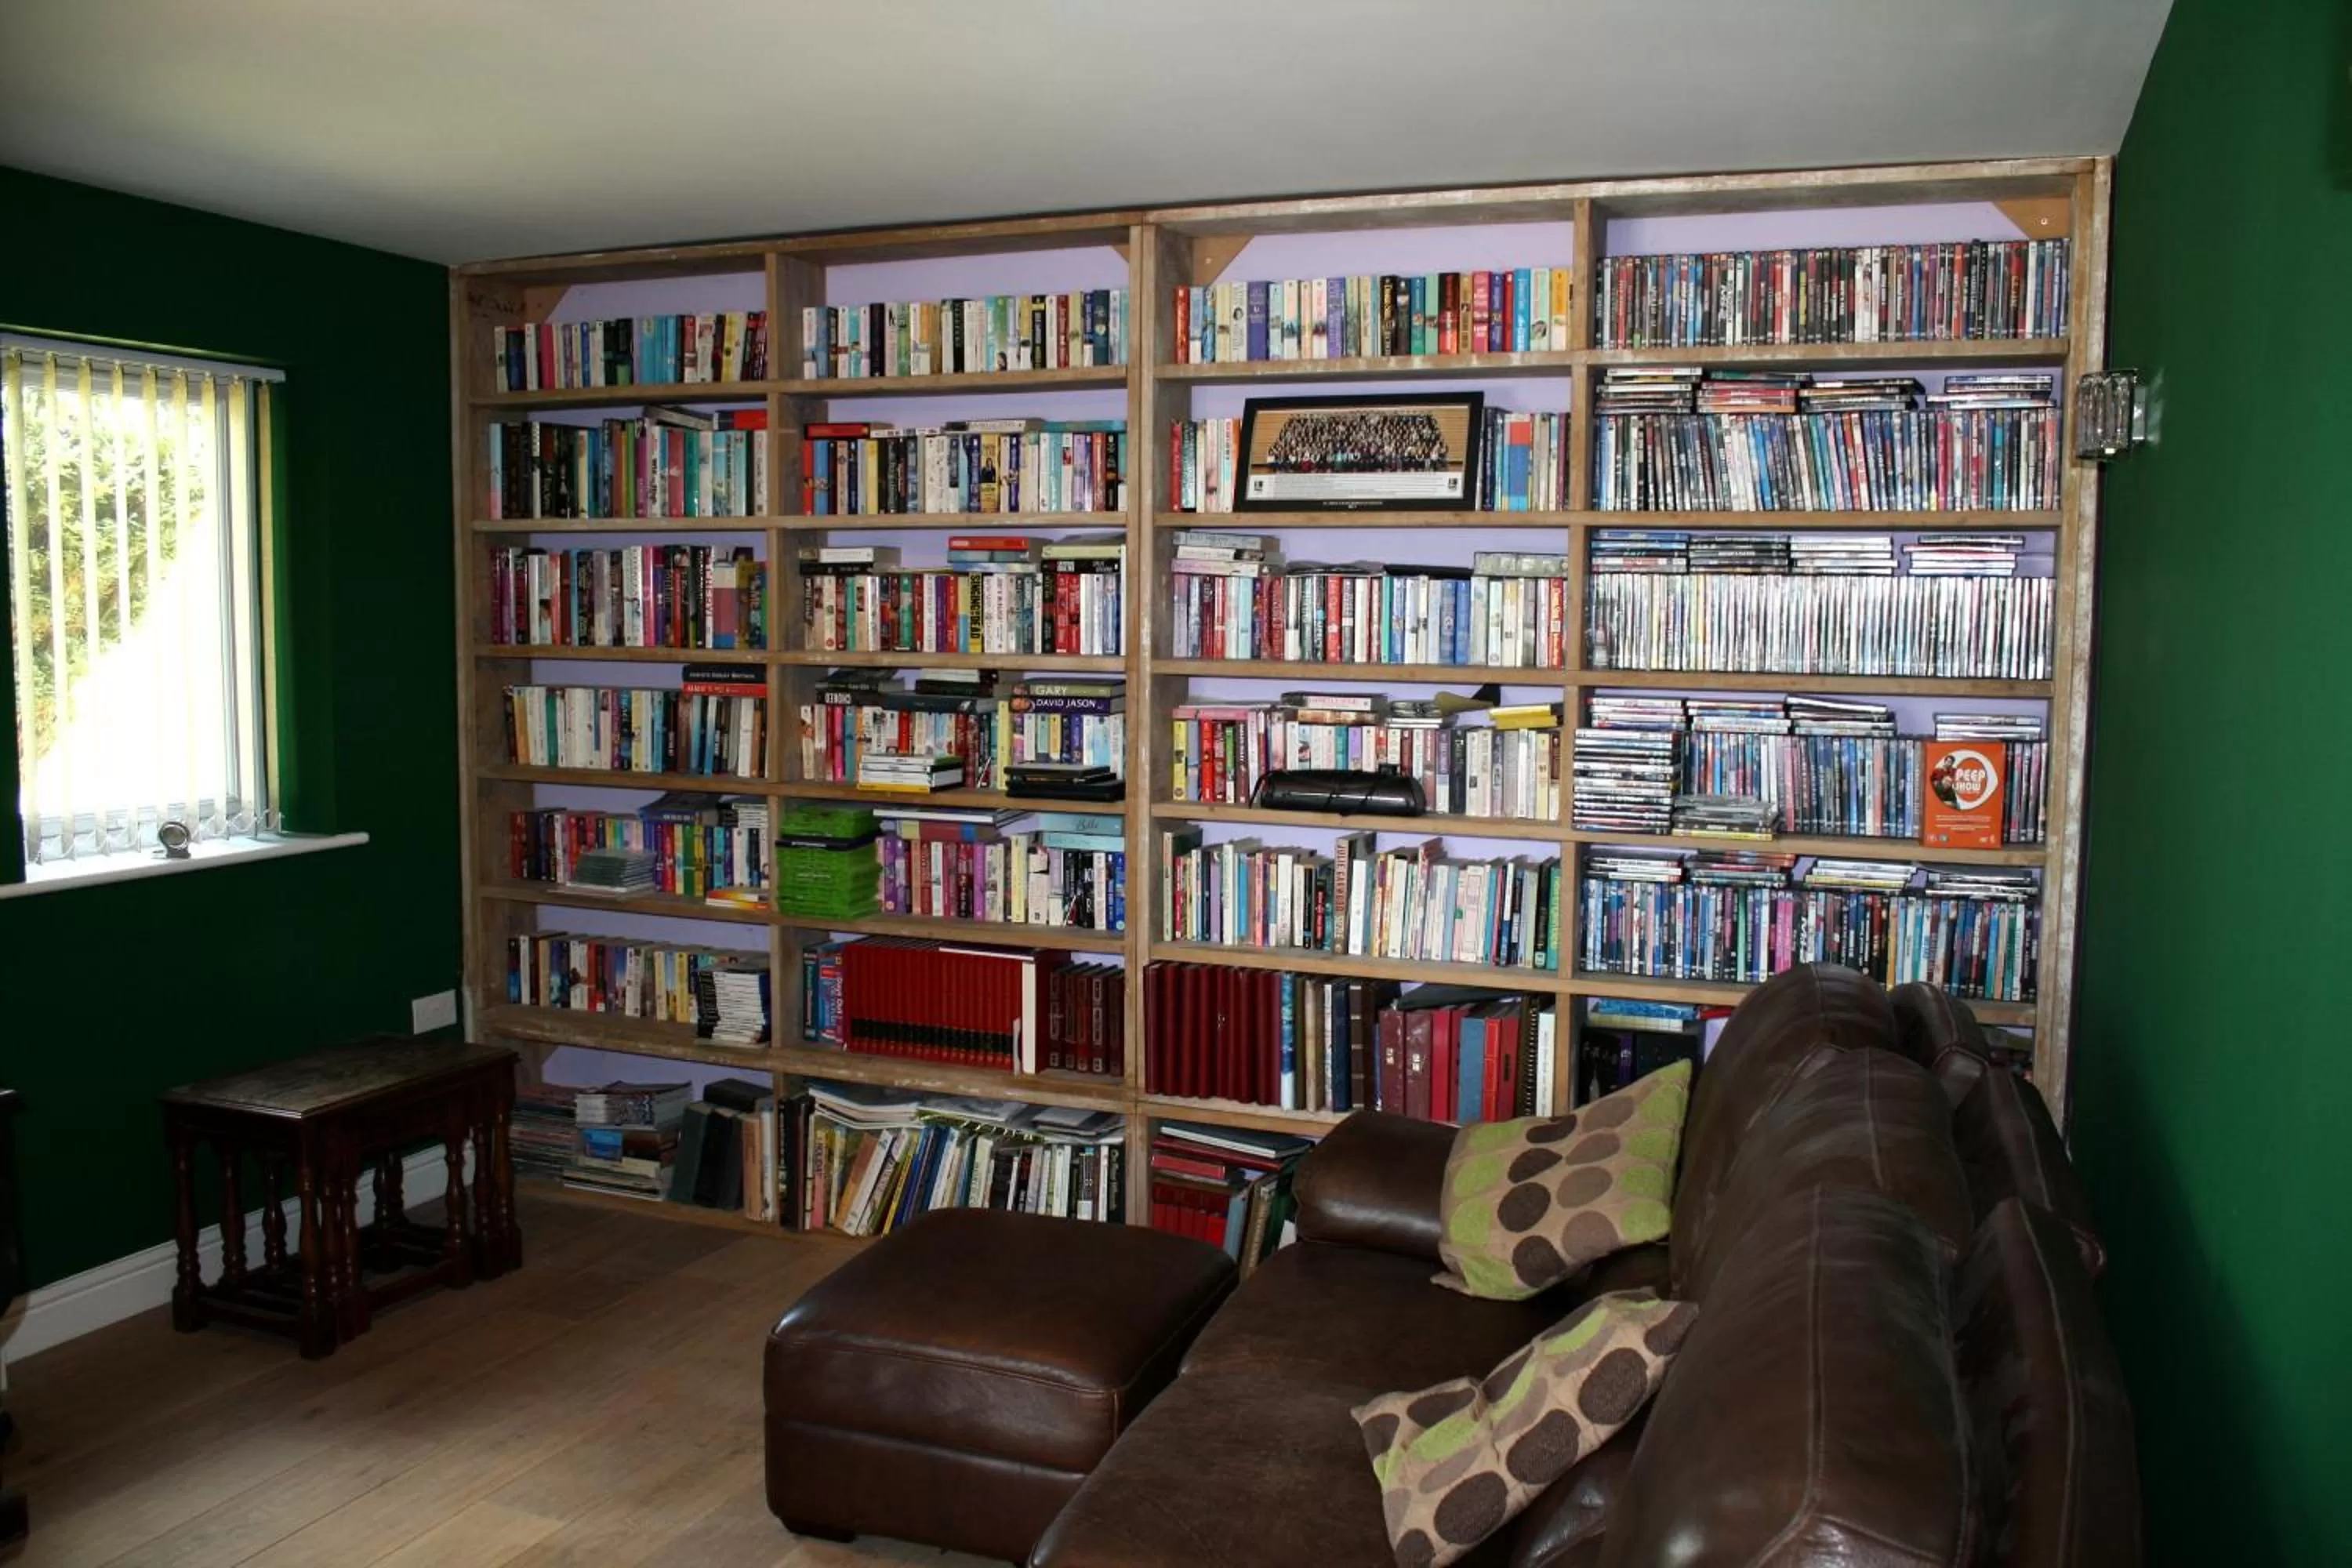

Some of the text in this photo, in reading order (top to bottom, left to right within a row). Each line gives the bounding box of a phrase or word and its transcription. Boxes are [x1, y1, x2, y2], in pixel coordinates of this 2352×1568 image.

[971, 615, 981, 639] DEAD
[1035, 685, 1067, 695] GARY
[1036, 699, 1096, 709] DAVID JASON
[1955, 768, 1986, 782] PEEP
[1951, 781, 1981, 792] SHOW
[1337, 845, 1346, 869] JULIE
